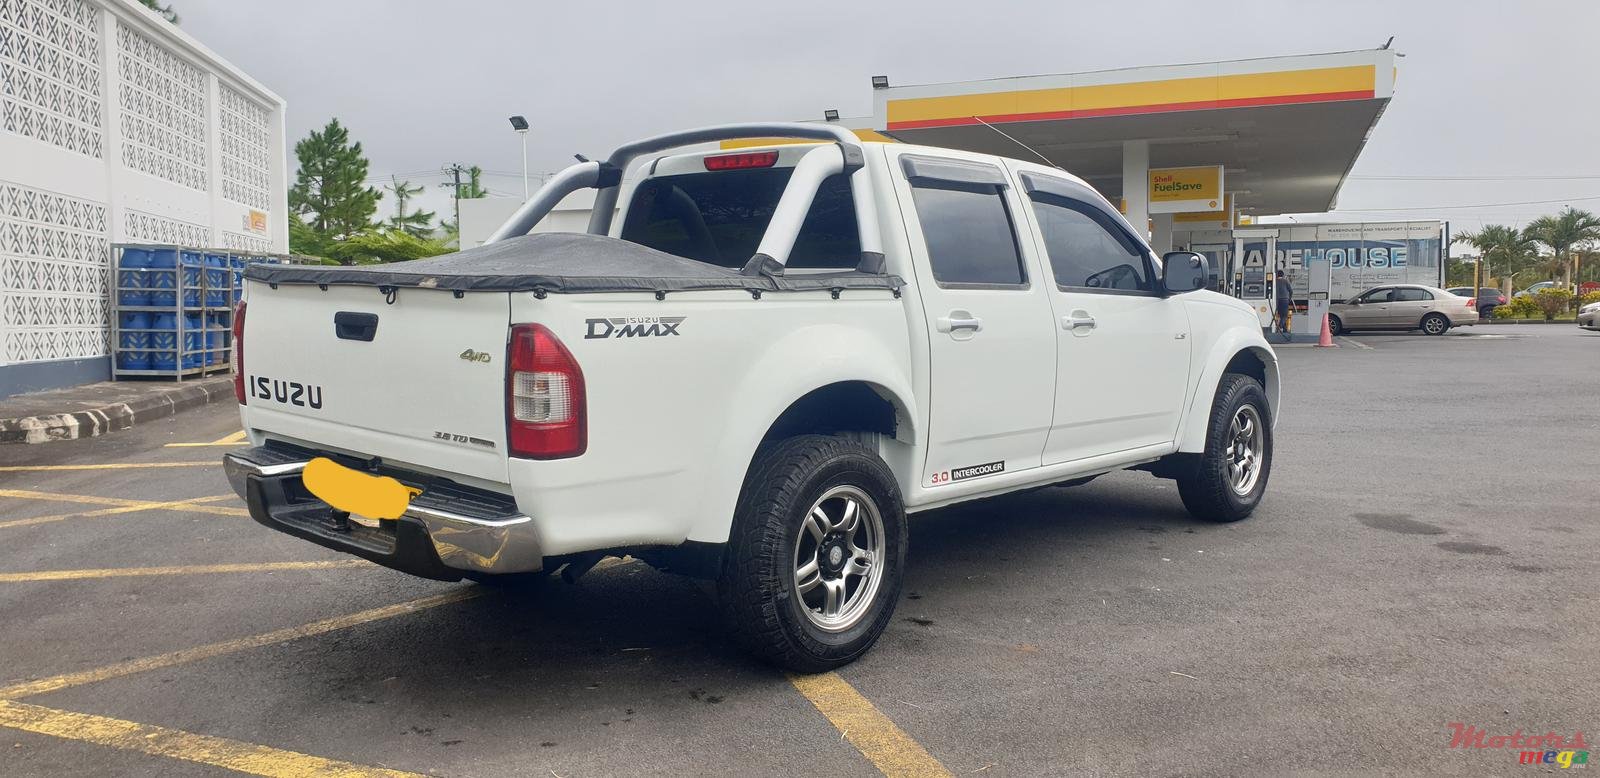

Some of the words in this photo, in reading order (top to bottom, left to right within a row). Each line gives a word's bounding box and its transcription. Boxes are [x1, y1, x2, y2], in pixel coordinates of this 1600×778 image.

[1153, 175, 1173, 183] Shell
[1153, 182, 1202, 192] FuelSave
[460, 348, 492, 363] 4WD
[250, 375, 323, 410] ISUZU
[931, 471, 949, 484] 3.0
[953, 462, 1003, 479] INTERCOOLER
